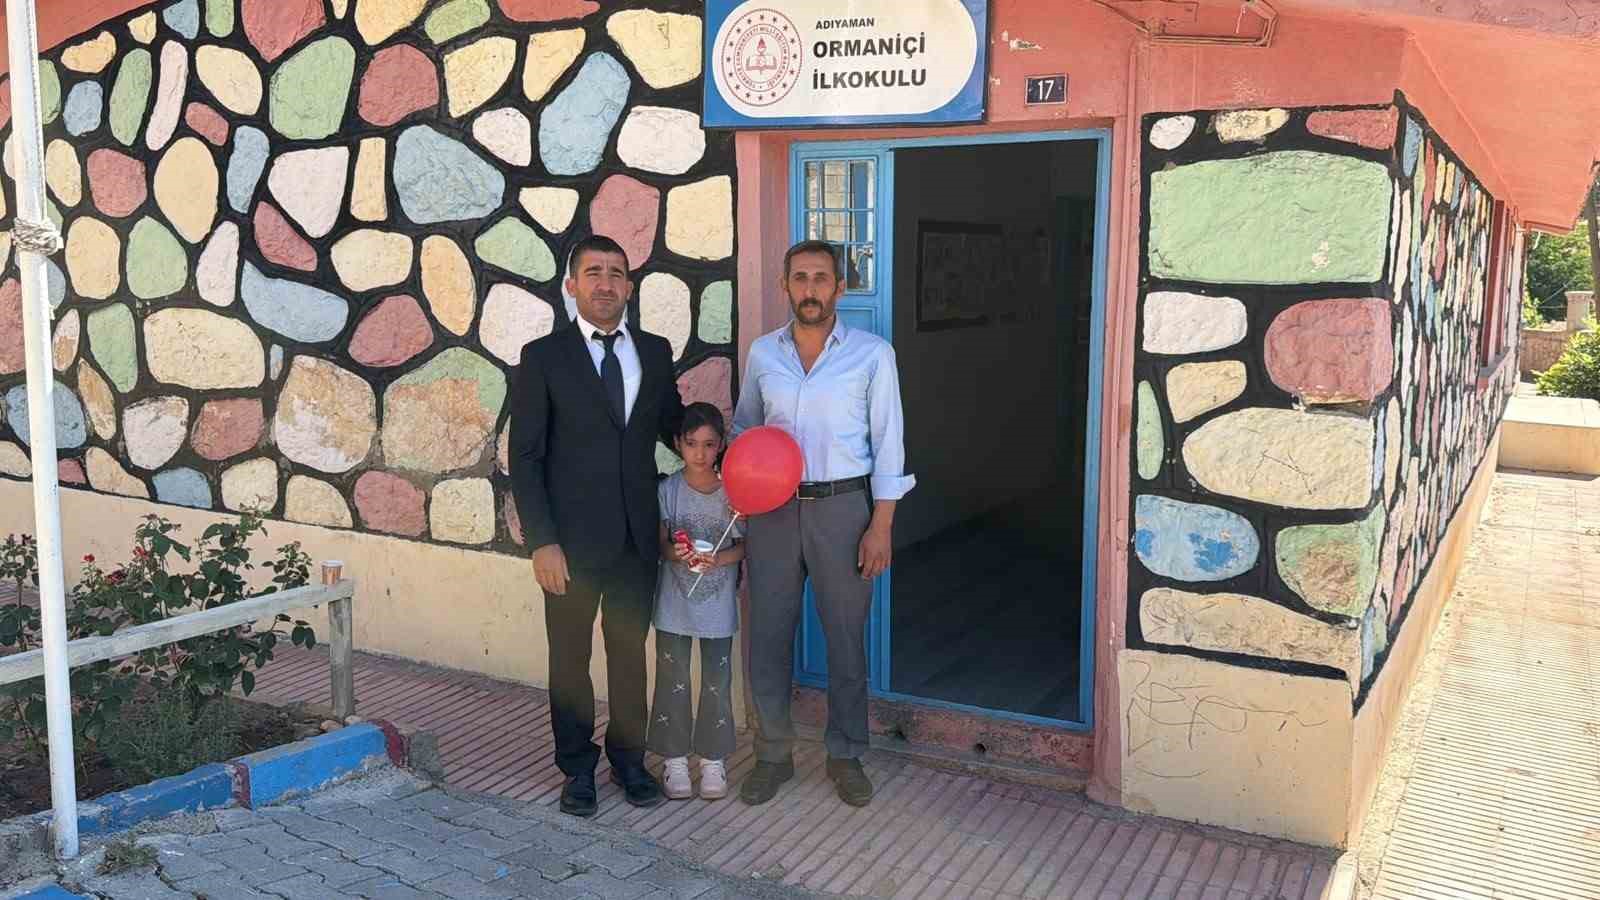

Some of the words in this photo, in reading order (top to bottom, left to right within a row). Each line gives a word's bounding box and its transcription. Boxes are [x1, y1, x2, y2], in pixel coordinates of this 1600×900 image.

[815, 18, 875, 30] ADIYAMAN
[813, 32, 926, 59] ORMANİÇİ
[812, 69, 927, 90] İLKOKULU
[1038, 80, 1054, 100] 17
